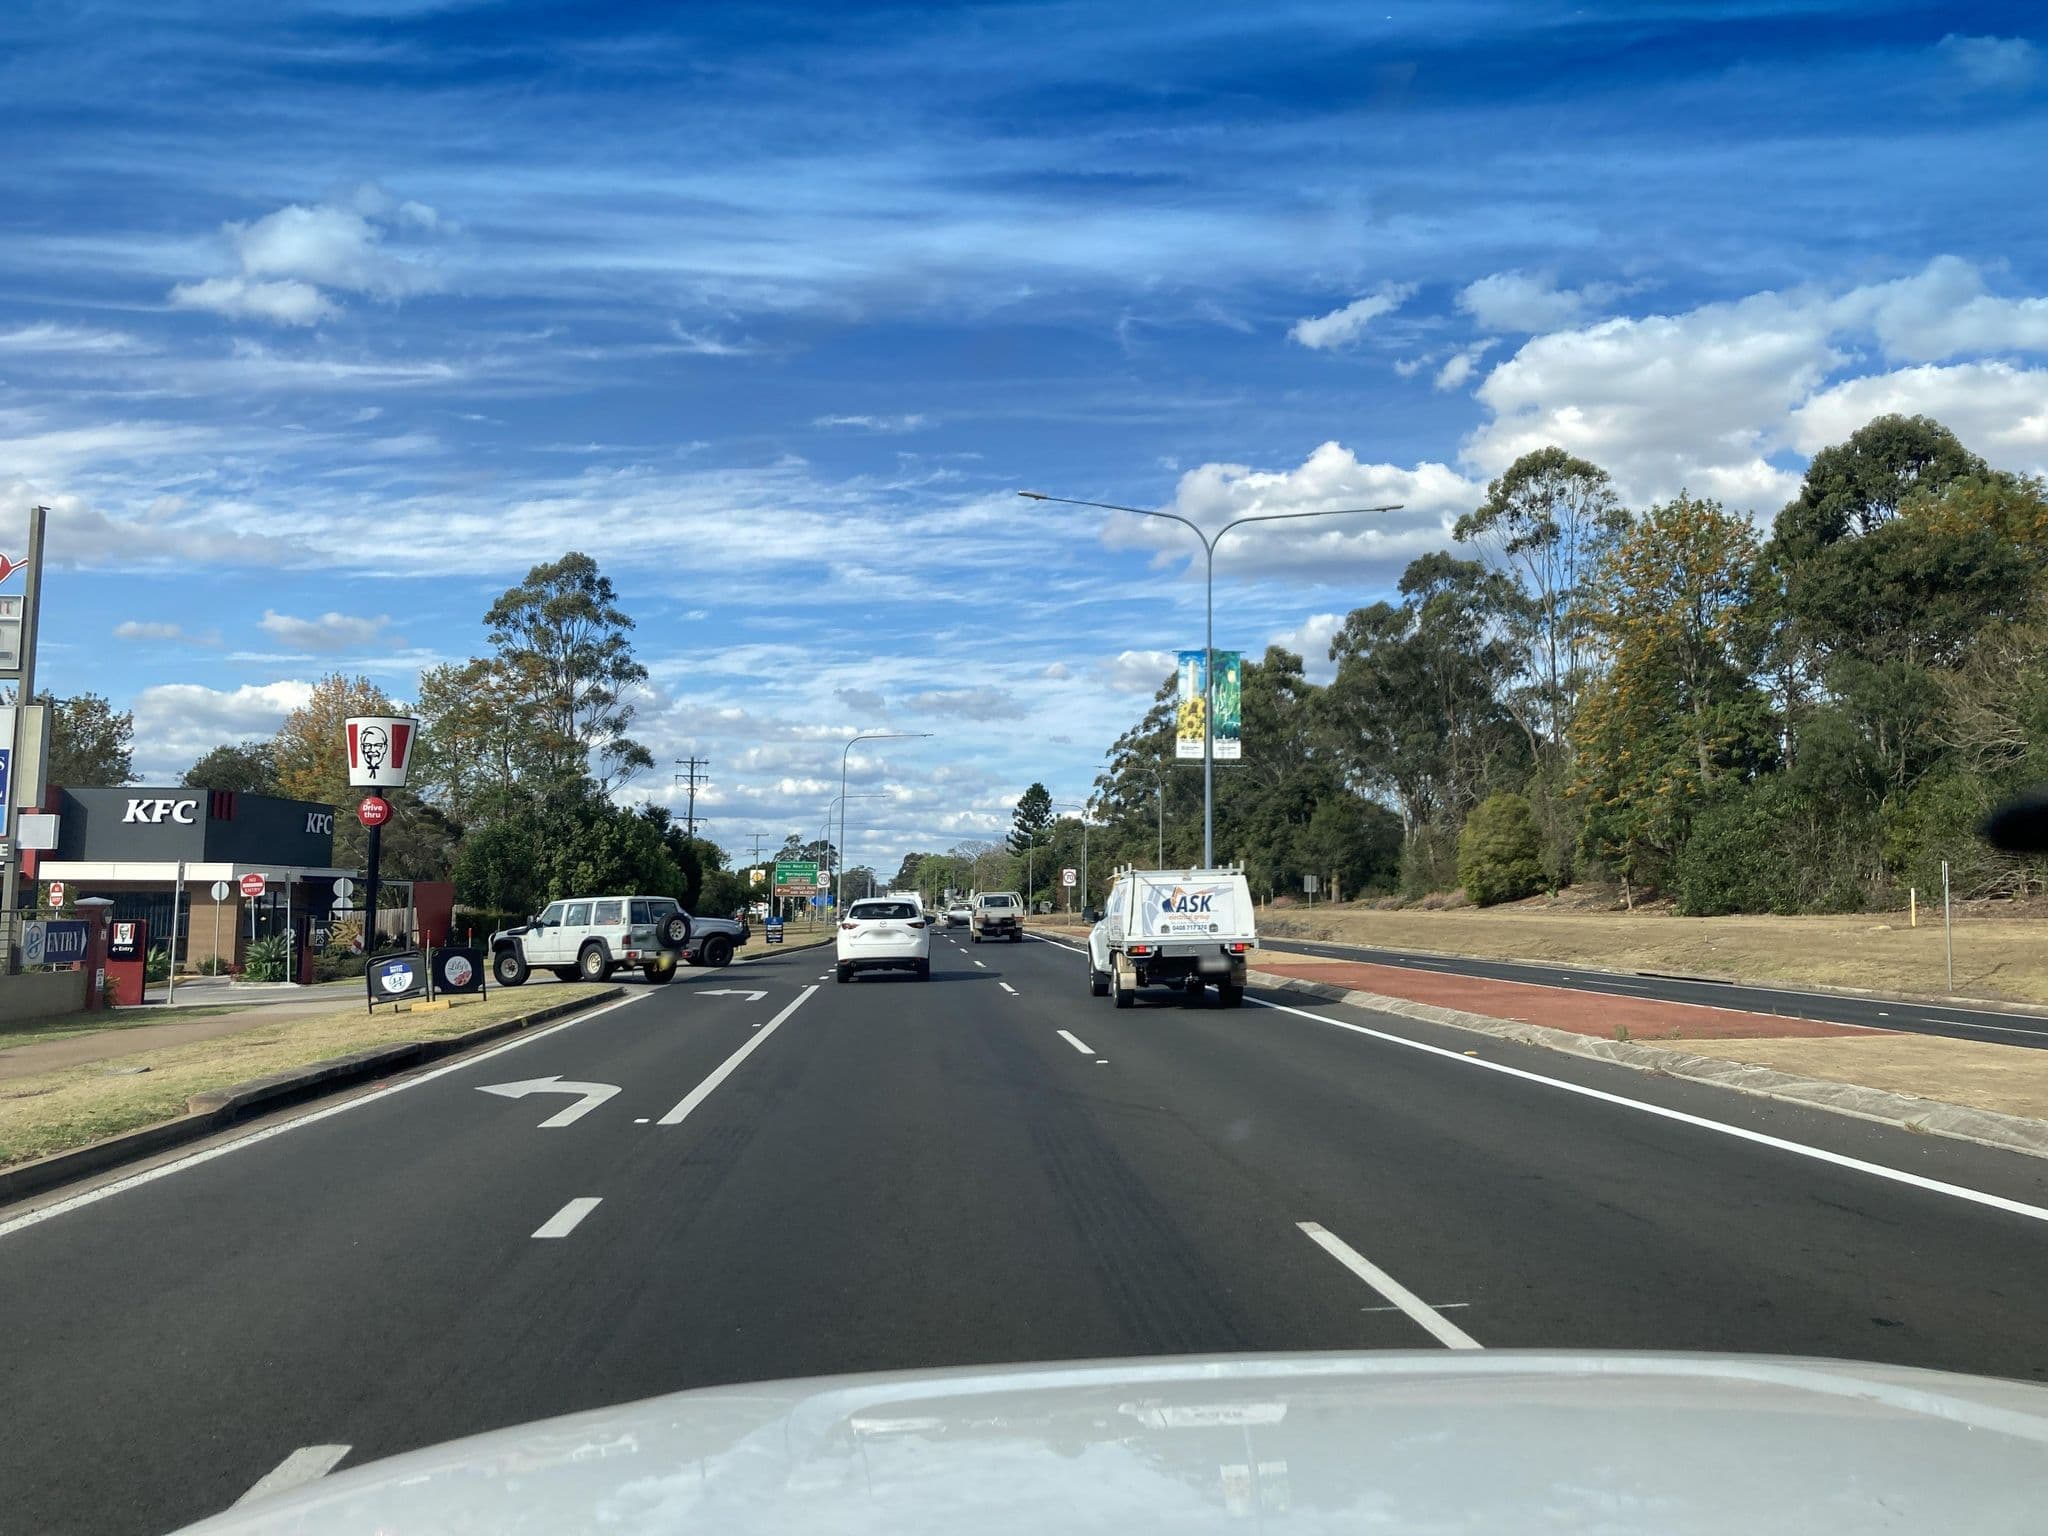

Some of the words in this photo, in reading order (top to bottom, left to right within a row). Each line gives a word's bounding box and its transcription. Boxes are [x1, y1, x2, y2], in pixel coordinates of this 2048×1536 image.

[122, 799, 198, 824] KFC
[362, 803, 383, 811] Drive
[306, 813, 333, 835] KFC
[1176, 895, 1213, 913] ASK
[47, 932, 80, 953] ENTRY
